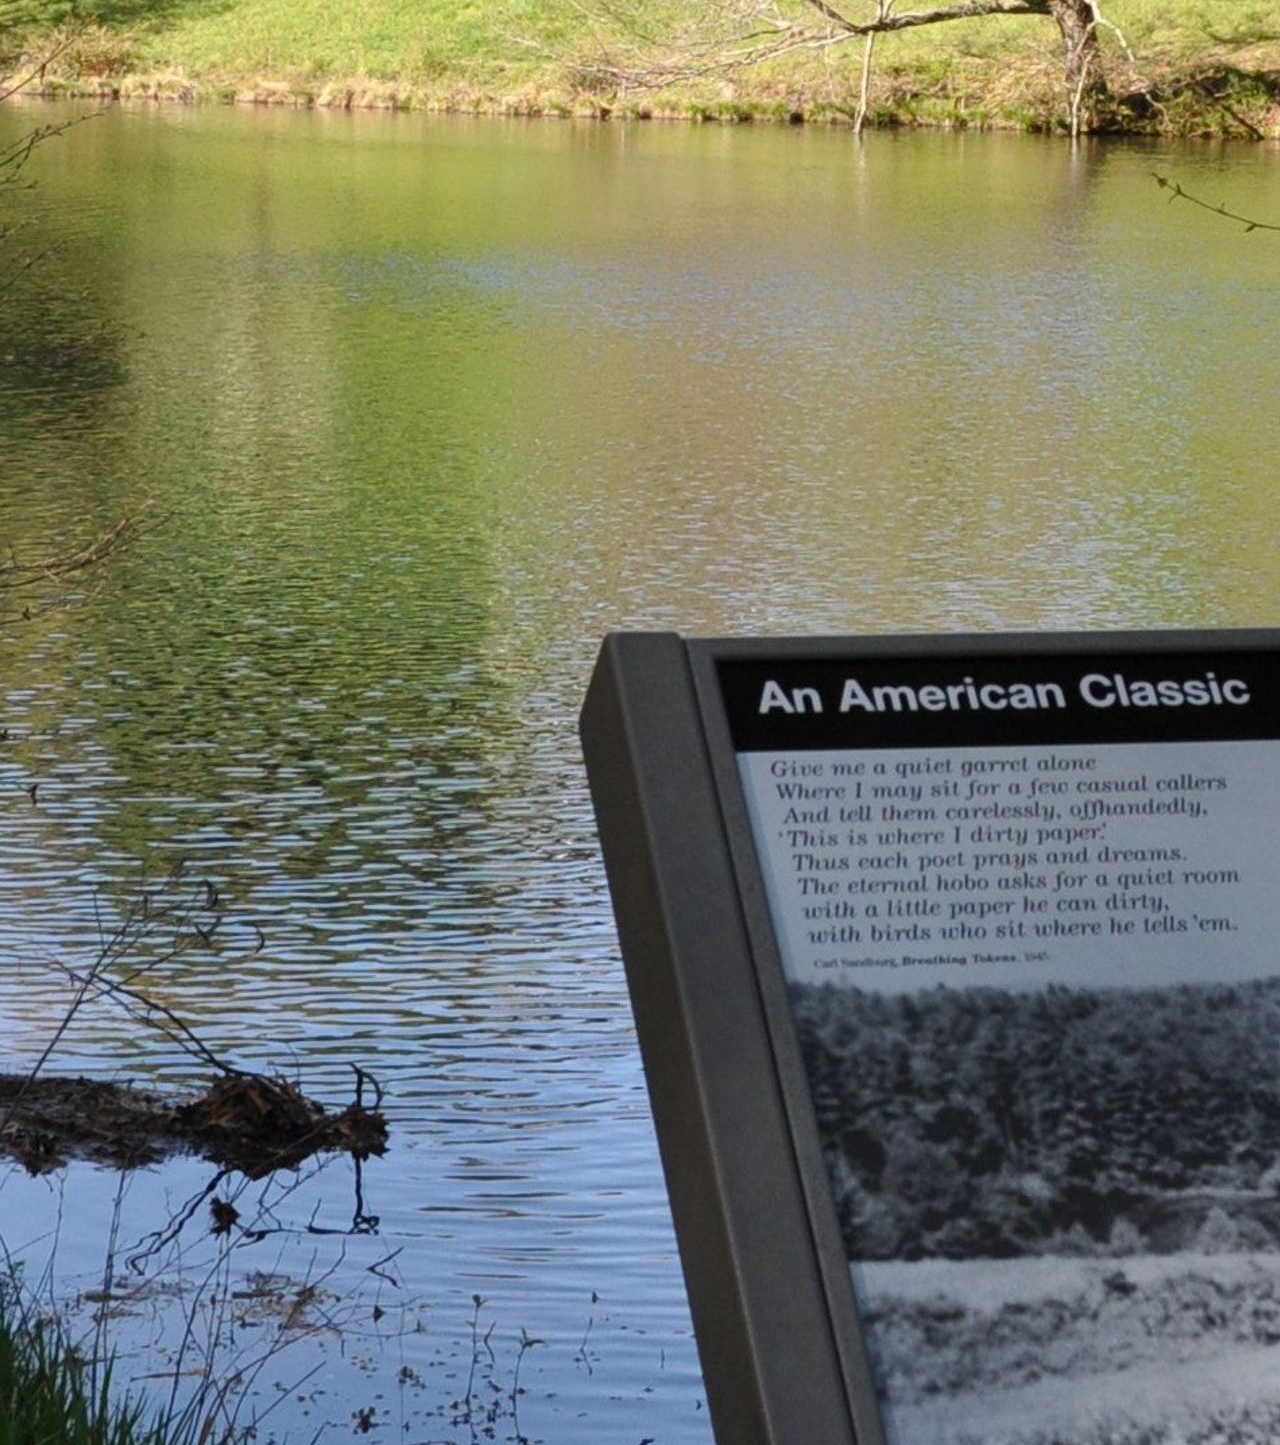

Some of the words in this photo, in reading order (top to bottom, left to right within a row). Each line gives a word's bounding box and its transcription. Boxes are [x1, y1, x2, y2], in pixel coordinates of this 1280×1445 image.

[759, 680, 823, 714] An
[840, 677, 1066, 712] American
[1079, 672, 1250, 708] Classic
[770, 760, 823, 778] Give
[830, 763, 866, 776] me
[895, 757, 953, 779] quiet
[960, 757, 1030, 777] garret
[1037, 754, 1096, 771] alone
[776, 783, 846, 800] Where
[871, 785, 922, 802] may
[930, 780, 959, 797] sit
[965, 779, 1001, 801] for
[1027, 777, 1068, 799] few
[1076, 775, 1147, 794] casual
[1155, 773, 1227, 792] callers
[783, 806, 830, 825] And
[839, 805, 871, 823] tell
[881, 804, 936, 821] them
[945, 801, 1061, 822] carelessly,
[1069, 797, 1208, 821] offhandedly,
[847, 829, 868, 846] is
[876, 827, 945, 845] where
[970, 825, 1028, 846] dirty
[792, 853, 850, 872] Thus
[858, 851, 908, 870] each
[918, 851, 966, 873] poet
[973, 852, 1038, 871] prays
[1046, 846, 1090, 865] and
[1097, 846, 1187, 863] dreams.
[797, 877, 840, 896] The
[847, 874, 928, 894] eternal
[937, 873, 989, 892] hobo
[997, 872, 1047, 890] asks
[1052, 870, 1088, 893] for
[1117, 868, 1174, 890] quiet
[1182, 870, 1240, 884] room
[802, 901, 857, 920] with
[887, 899, 941, 917] little
[948, 901, 1016, 920] paper
[1023, 895, 1048, 914] he
[1056, 898, 1097, 912] can
[1105, 892, 1169, 913] dirty,
[808, 925, 862, 944] with
[870, 923, 931, 942] birds
[939, 921, 987, 940] who
[995, 920, 1026, 938] sit
[1032, 919, 1102, 937] where
[1110, 917, 1135, 935] he
[1143, 915, 1188, 934] tells
[813, 959, 838, 968] Carl
[901, 955, 967, 967] Breathing
